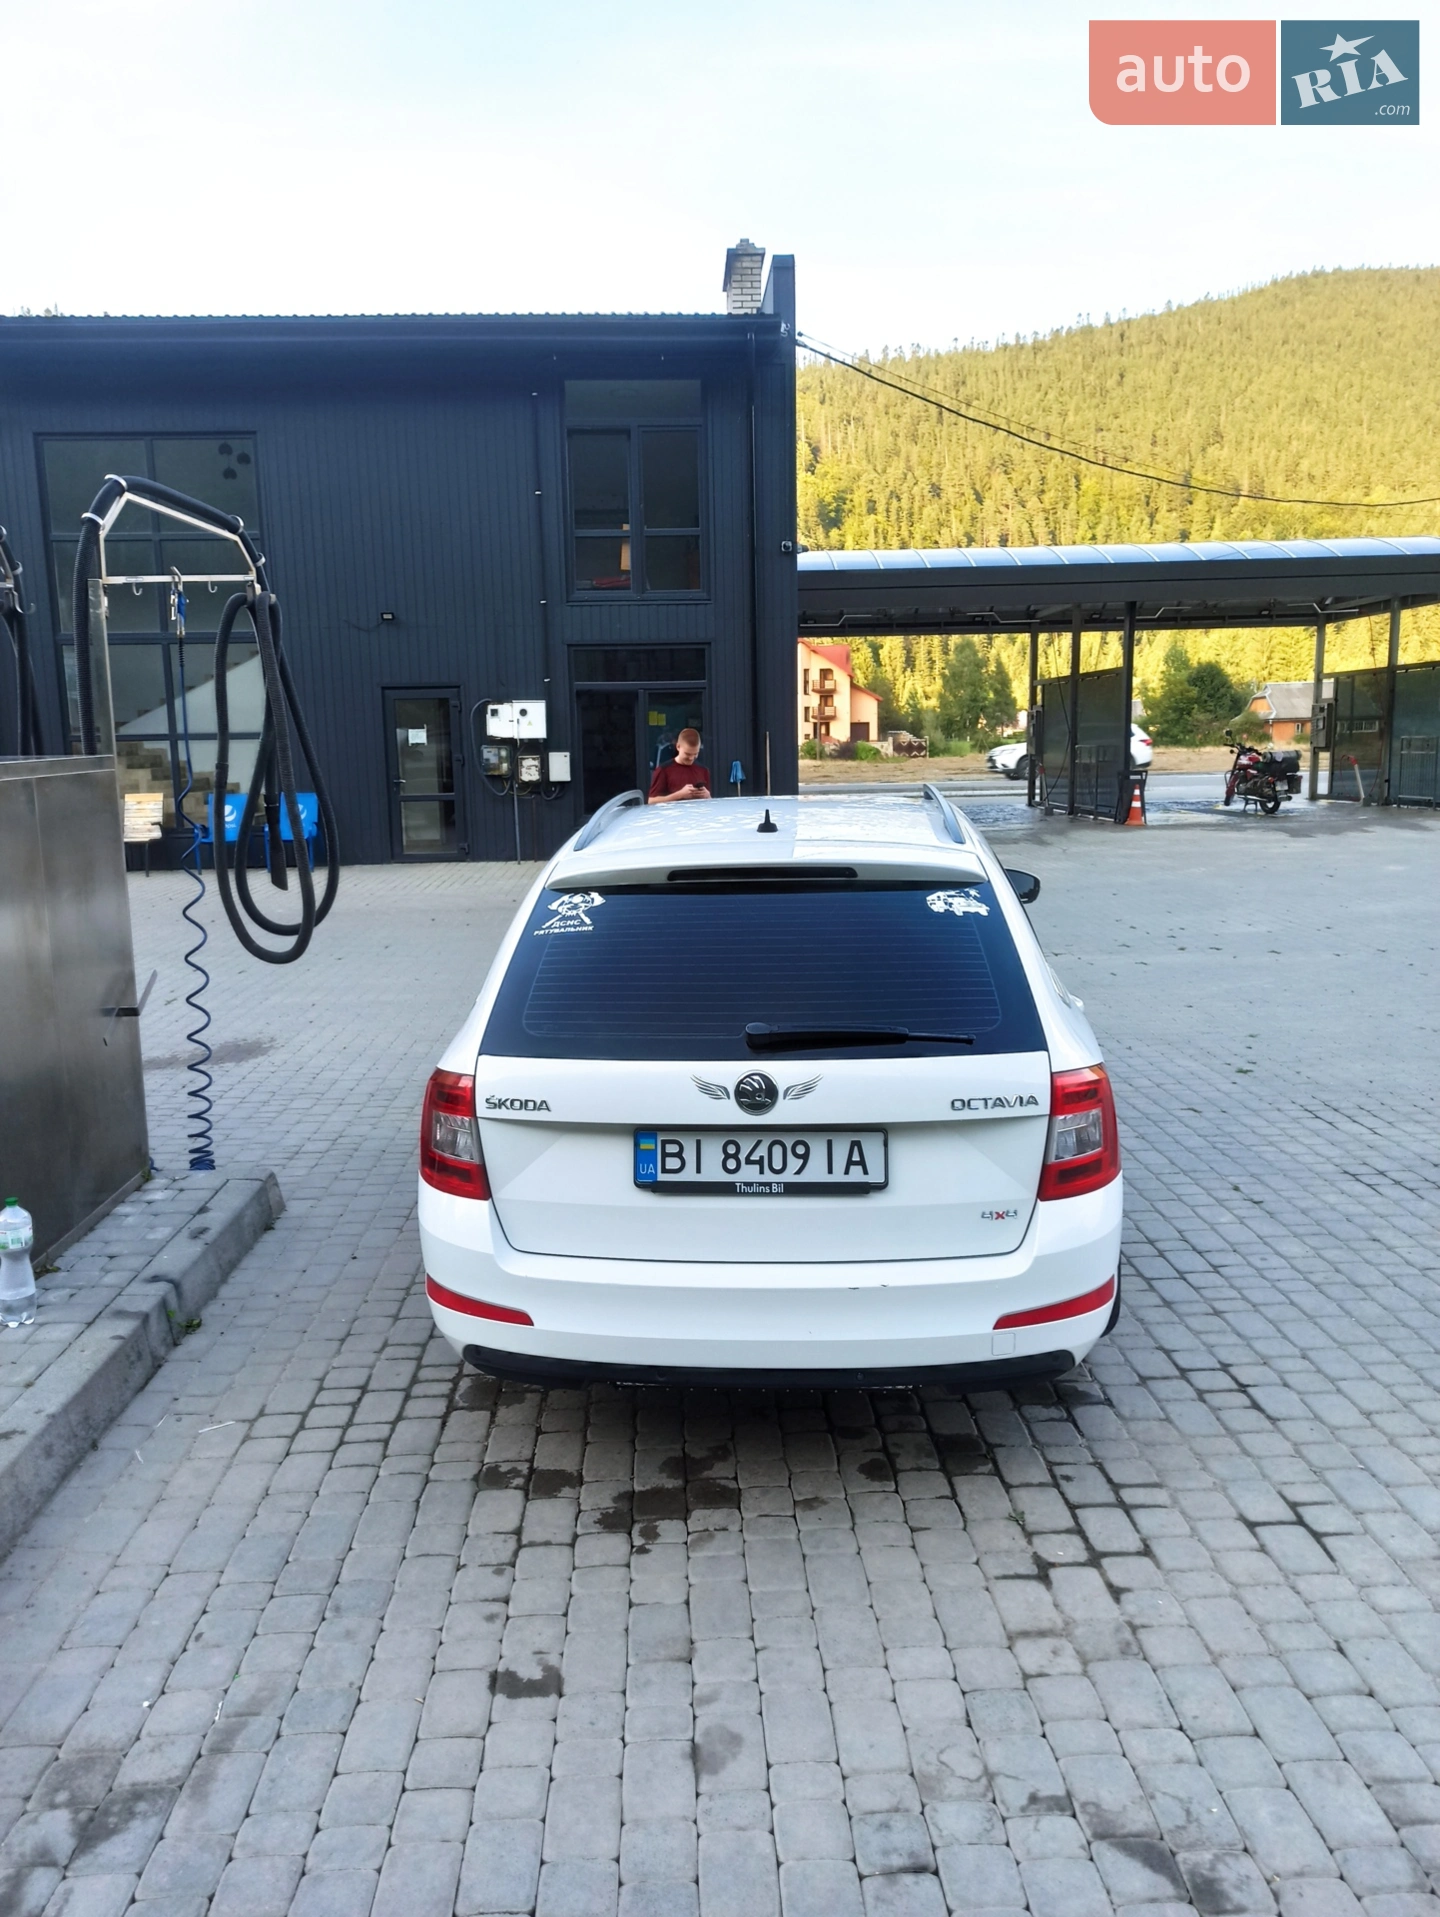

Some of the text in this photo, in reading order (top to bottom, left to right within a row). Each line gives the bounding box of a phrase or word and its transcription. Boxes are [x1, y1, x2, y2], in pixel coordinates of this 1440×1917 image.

[485, 1095, 551, 1112] ŠKODA
[951, 1094, 1039, 1111] OCTAVIA
[721, 1139, 811, 1175] 8409
[639, 1163, 655, 1175] UA
[735, 1183, 784, 1194] Thulins Bil
